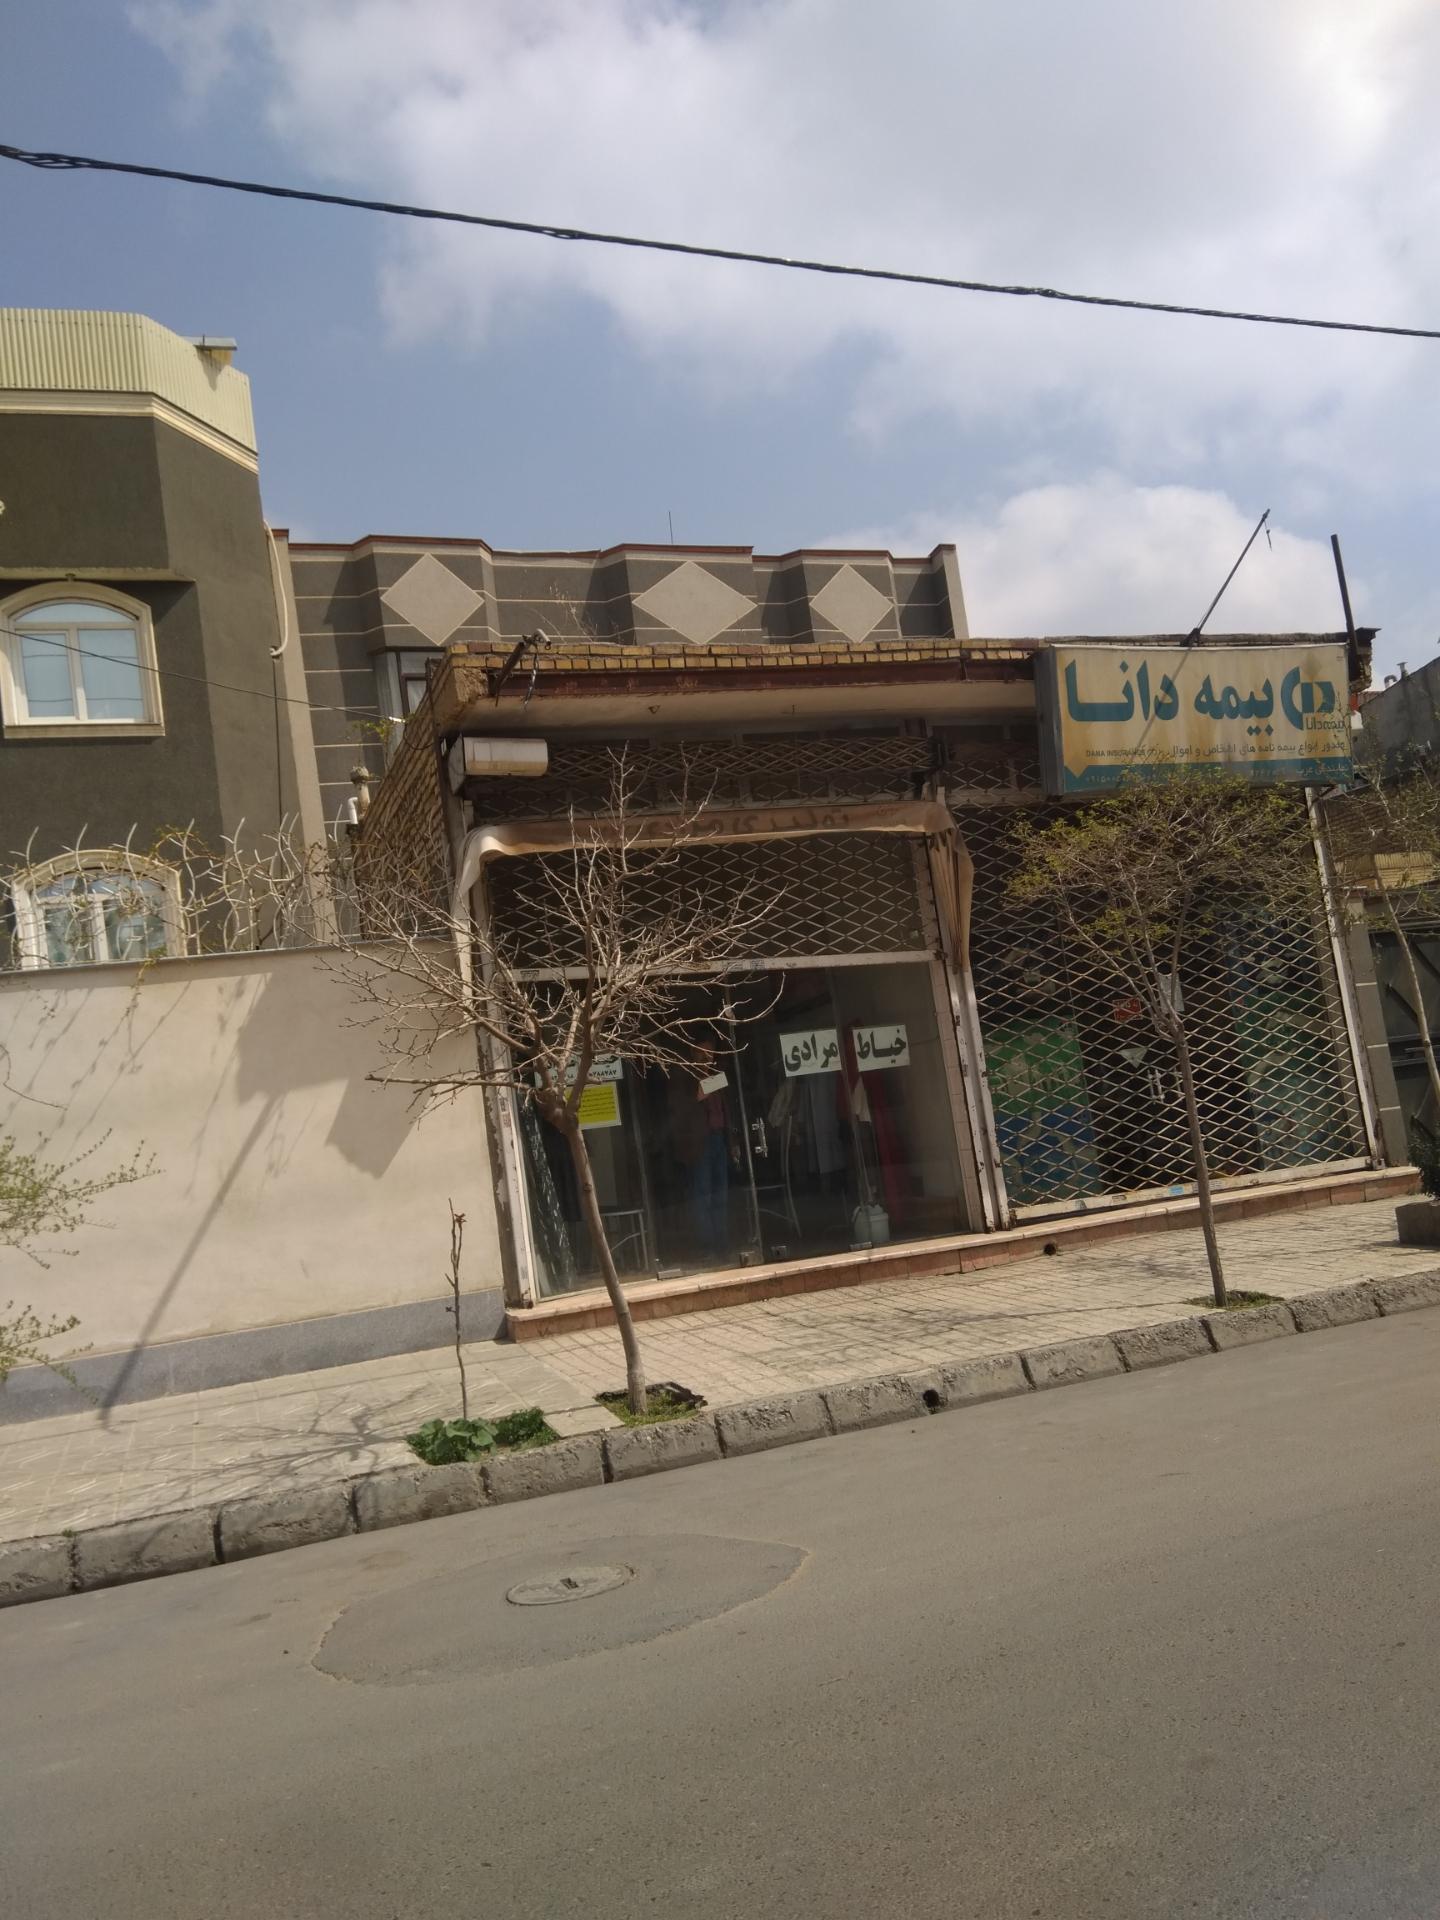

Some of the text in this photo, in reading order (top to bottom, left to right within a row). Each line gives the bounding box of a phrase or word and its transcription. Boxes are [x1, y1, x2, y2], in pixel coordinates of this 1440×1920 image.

[1065, 659, 1274, 736] بیمه دانا
[1305, 716, 1322, 730] دانا
[1194, 747, 1201, 757] و
[1239, 743, 1256, 756] های
[785, 1028, 907, 1072] خیاط مرادی
